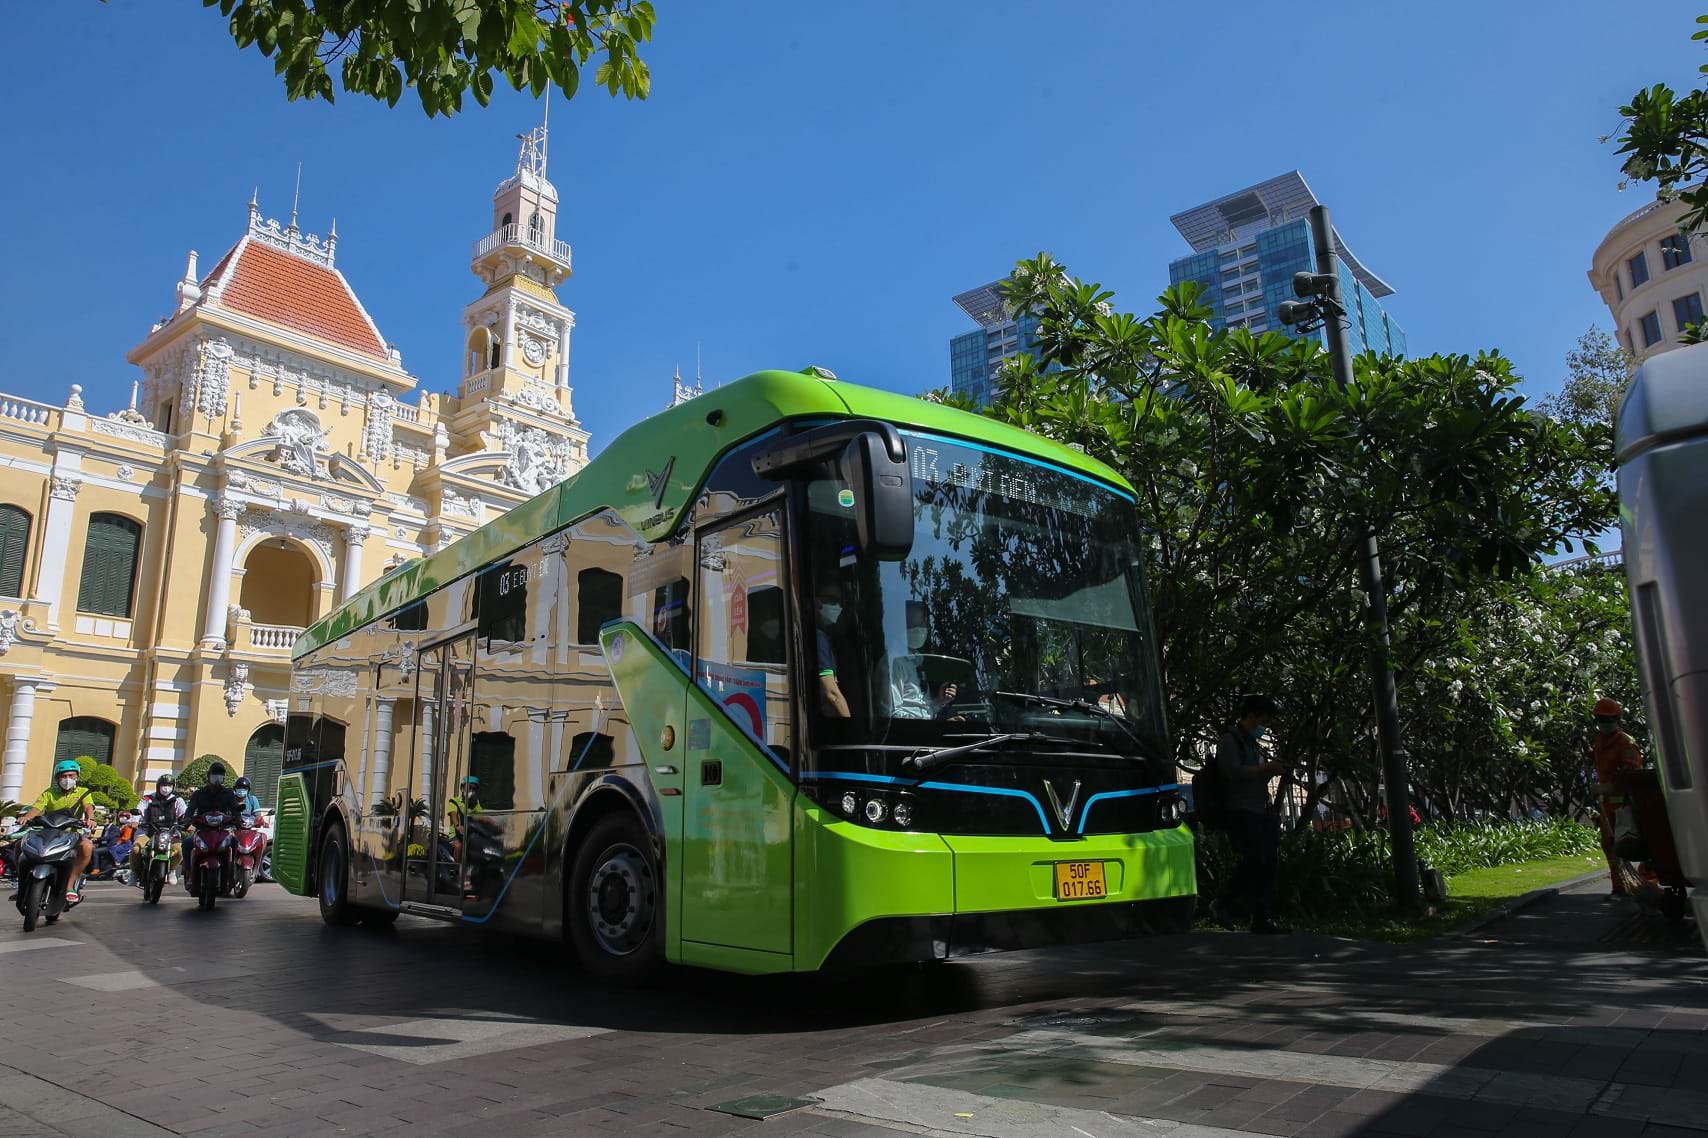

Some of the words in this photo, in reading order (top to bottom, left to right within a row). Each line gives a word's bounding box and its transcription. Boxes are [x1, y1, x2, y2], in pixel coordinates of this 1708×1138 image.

[913, 446, 938, 483] 03
[640, 507, 675, 531] VINBUS
[500, 572, 510, 596] 03
[1069, 863, 1090, 879] 50F
[1063, 880, 1102, 897] 017.66
